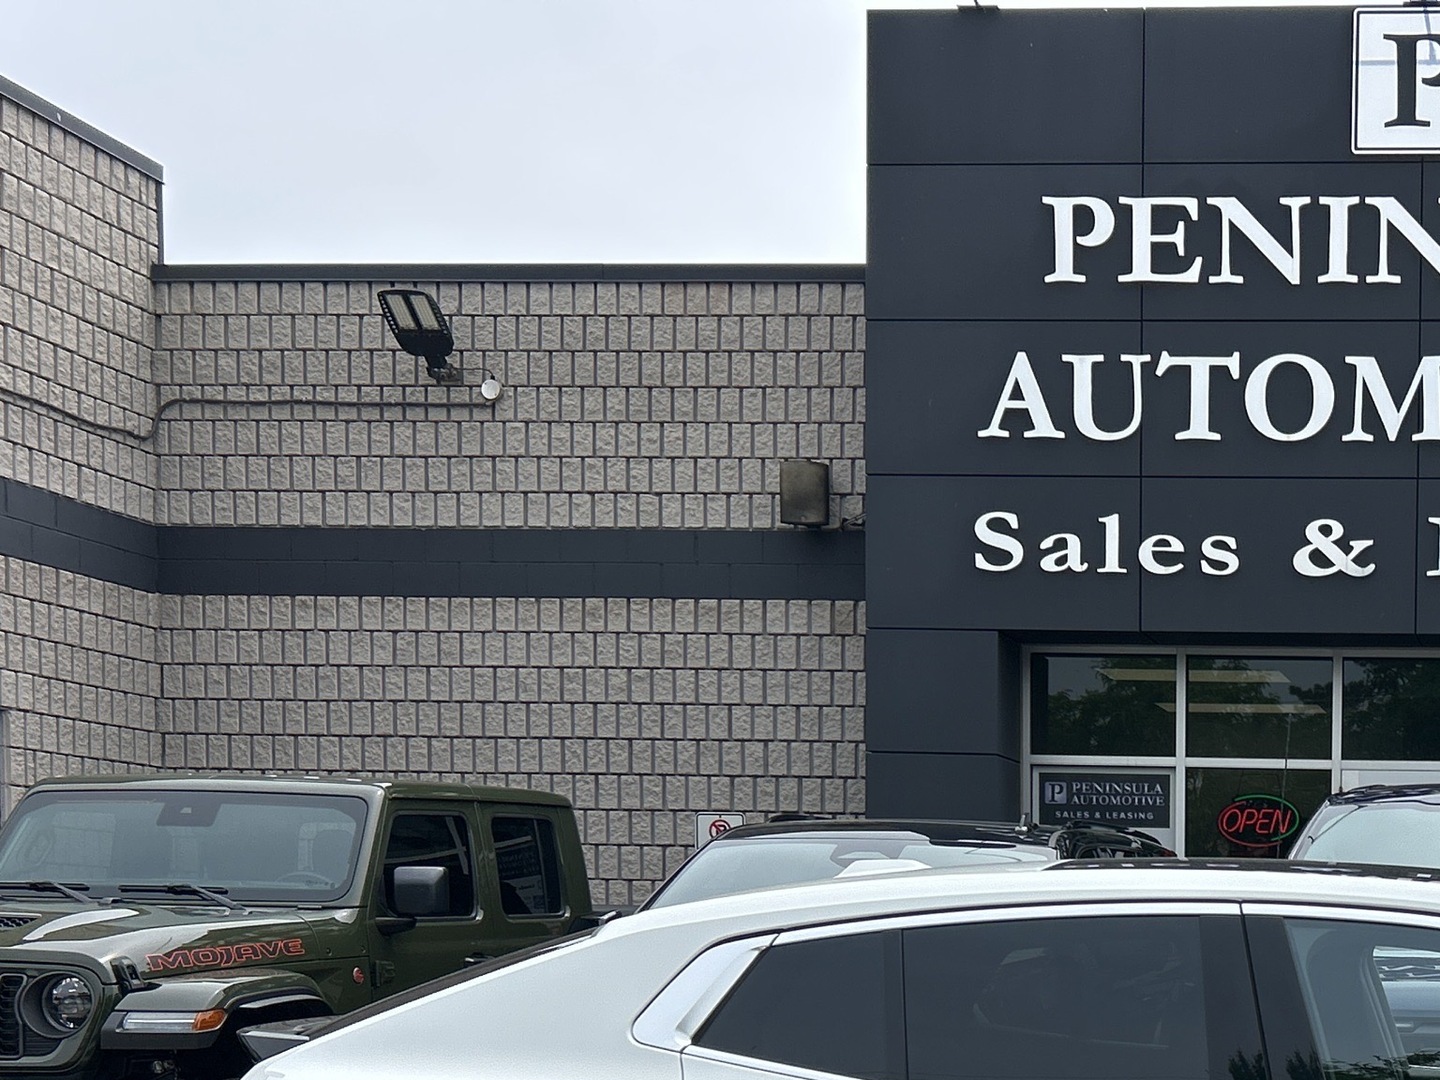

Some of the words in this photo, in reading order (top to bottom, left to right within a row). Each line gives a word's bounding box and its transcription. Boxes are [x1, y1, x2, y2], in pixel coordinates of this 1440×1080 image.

[973, 511, 1240, 577] Sales
[1292, 517, 1376, 578] &
[1071, 782, 1163, 795] PENINSULA
[1071, 795, 1165, 806] AUTOMOTIVE
[1055, 811, 1090, 819] SALES
[1094, 811, 1101, 819] &
[1106, 811, 1154, 820] LEASING
[1222, 808, 1292, 834] OPEN
[145, 938, 306, 972] MOJAVE
